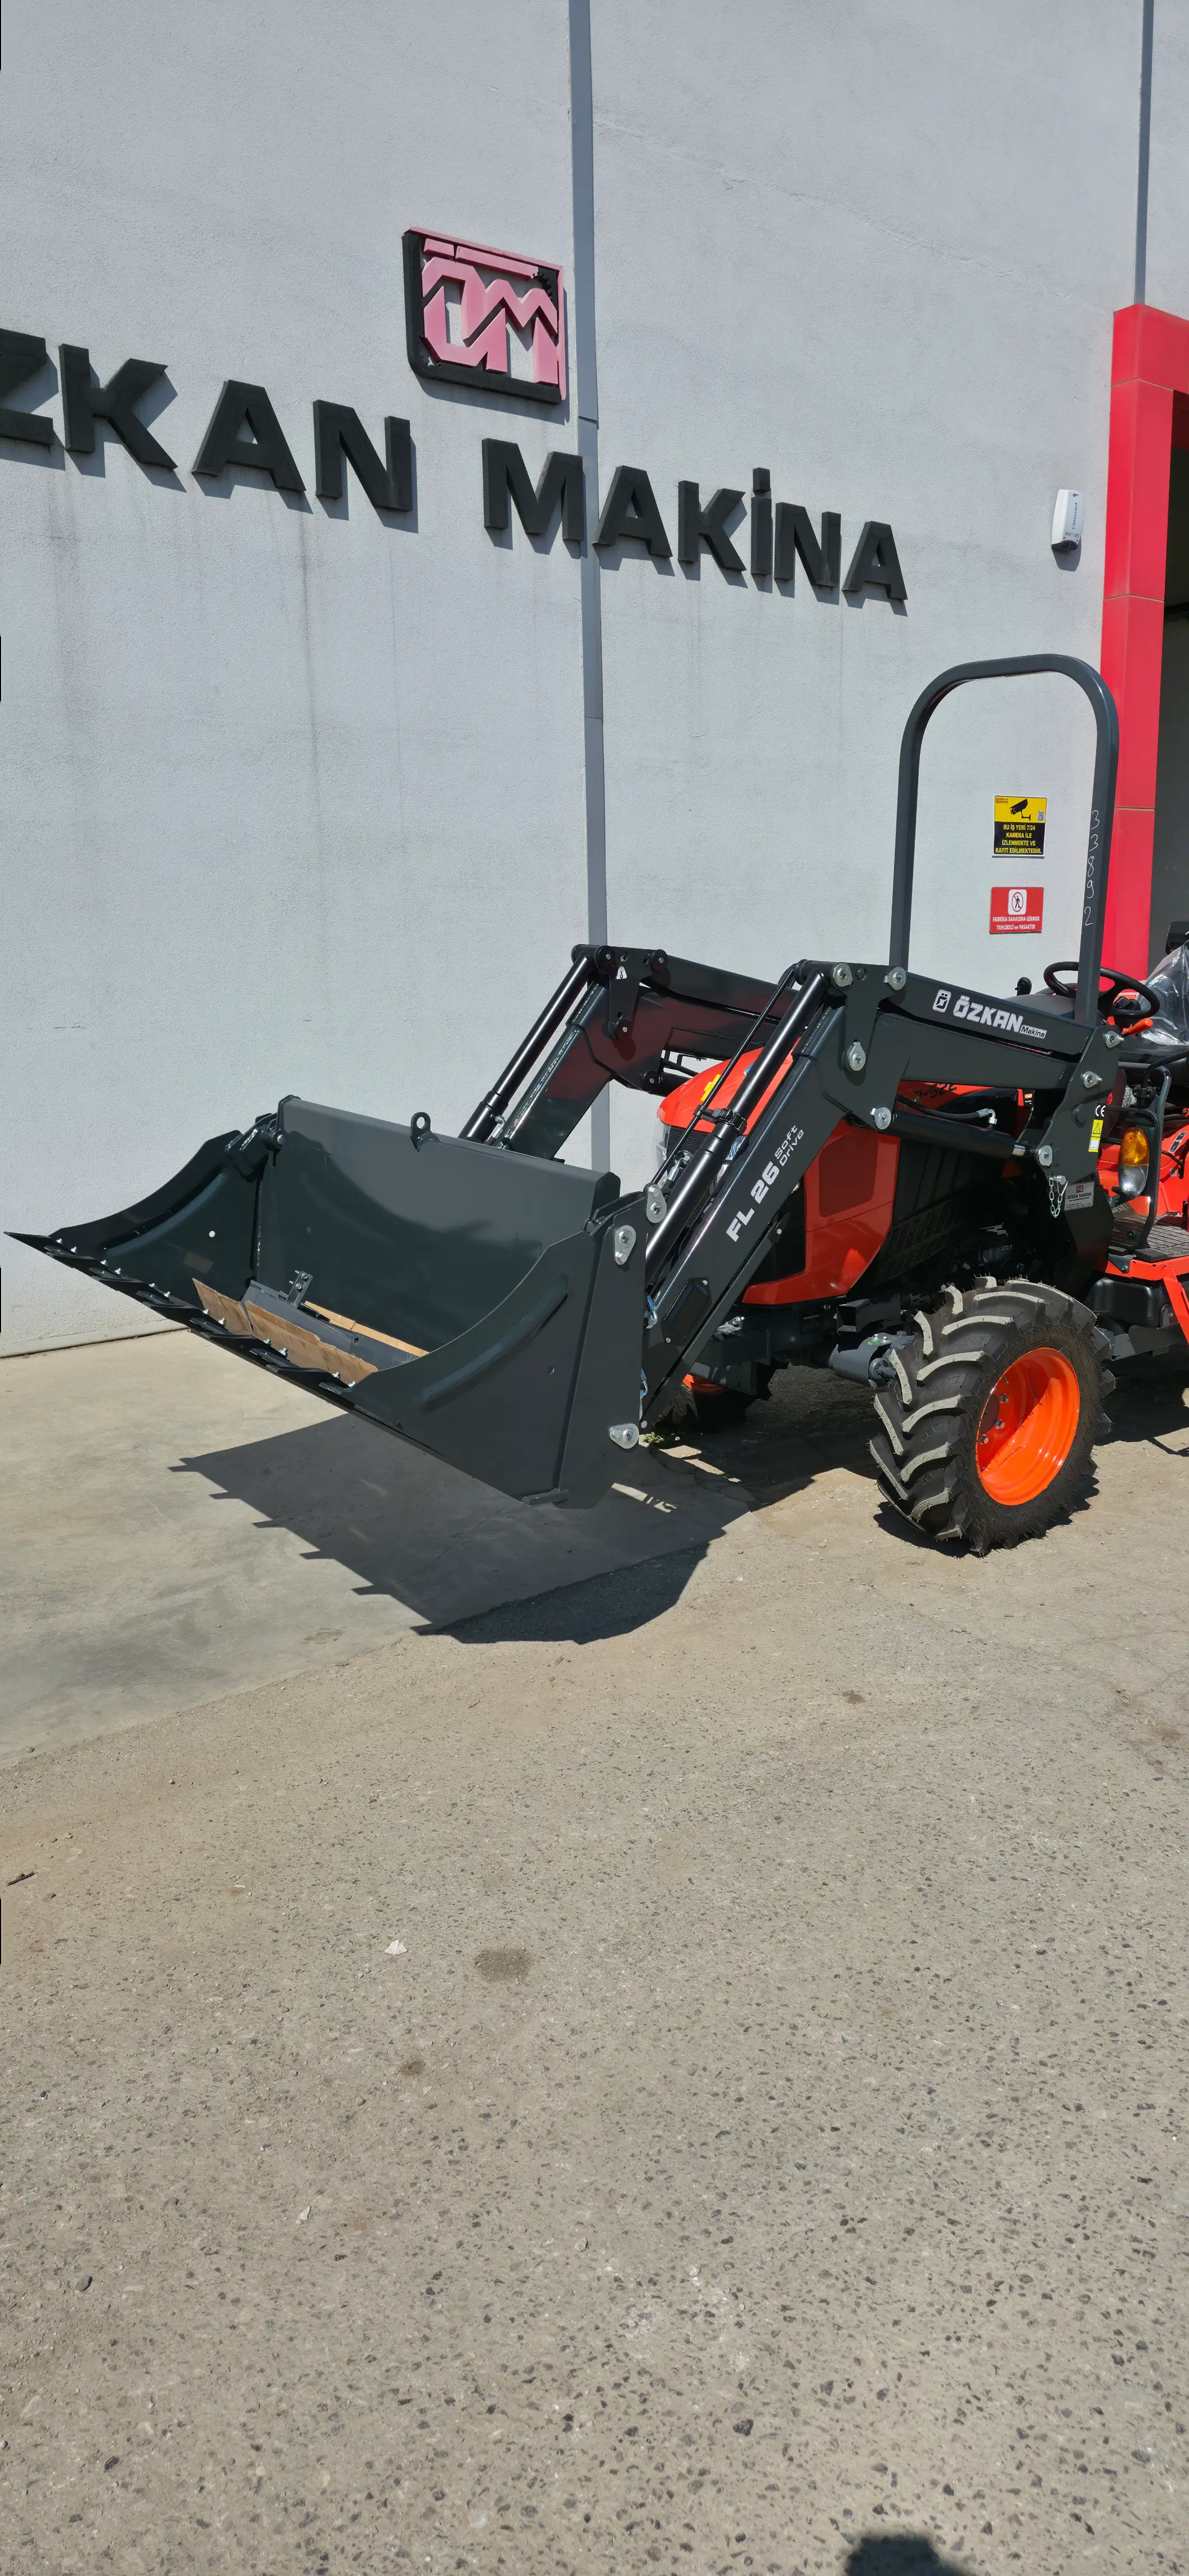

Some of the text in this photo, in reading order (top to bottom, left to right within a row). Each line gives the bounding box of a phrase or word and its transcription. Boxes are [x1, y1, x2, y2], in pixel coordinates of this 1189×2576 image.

[482, 437, 908, 601] MAKİNA
[1084, 810, 1100, 926] 33892
[953, 995, 1023, 1033] ÖZKAN
[1021, 1026, 1045, 1038] Makina
[1095, 1105, 1106, 1117] CE
[774, 1125, 798, 1160] Soft
[779, 1129, 804, 1166] Drive
[726, 1161, 780, 1242] FL 26
